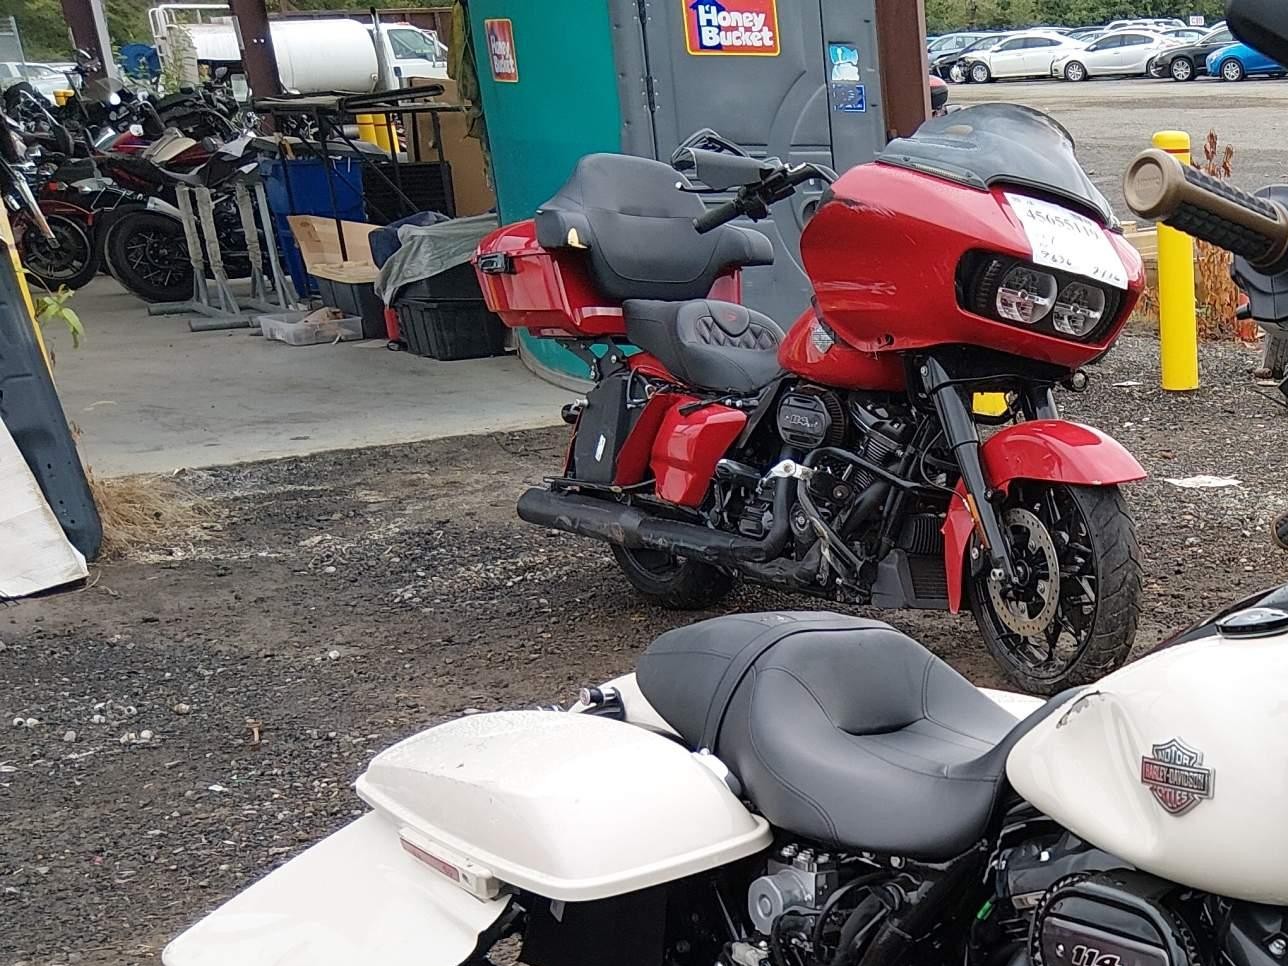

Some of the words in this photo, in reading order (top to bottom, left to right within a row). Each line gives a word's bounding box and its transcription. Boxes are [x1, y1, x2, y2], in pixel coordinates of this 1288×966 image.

[698, 4, 766, 29] Honey
[490, 35, 511, 59] Honey
[700, 26, 774, 47] Bucket
[493, 55, 516, 74] Bucket
[1144, 762, 1205, 790] HARLEY-DAVIDSON
